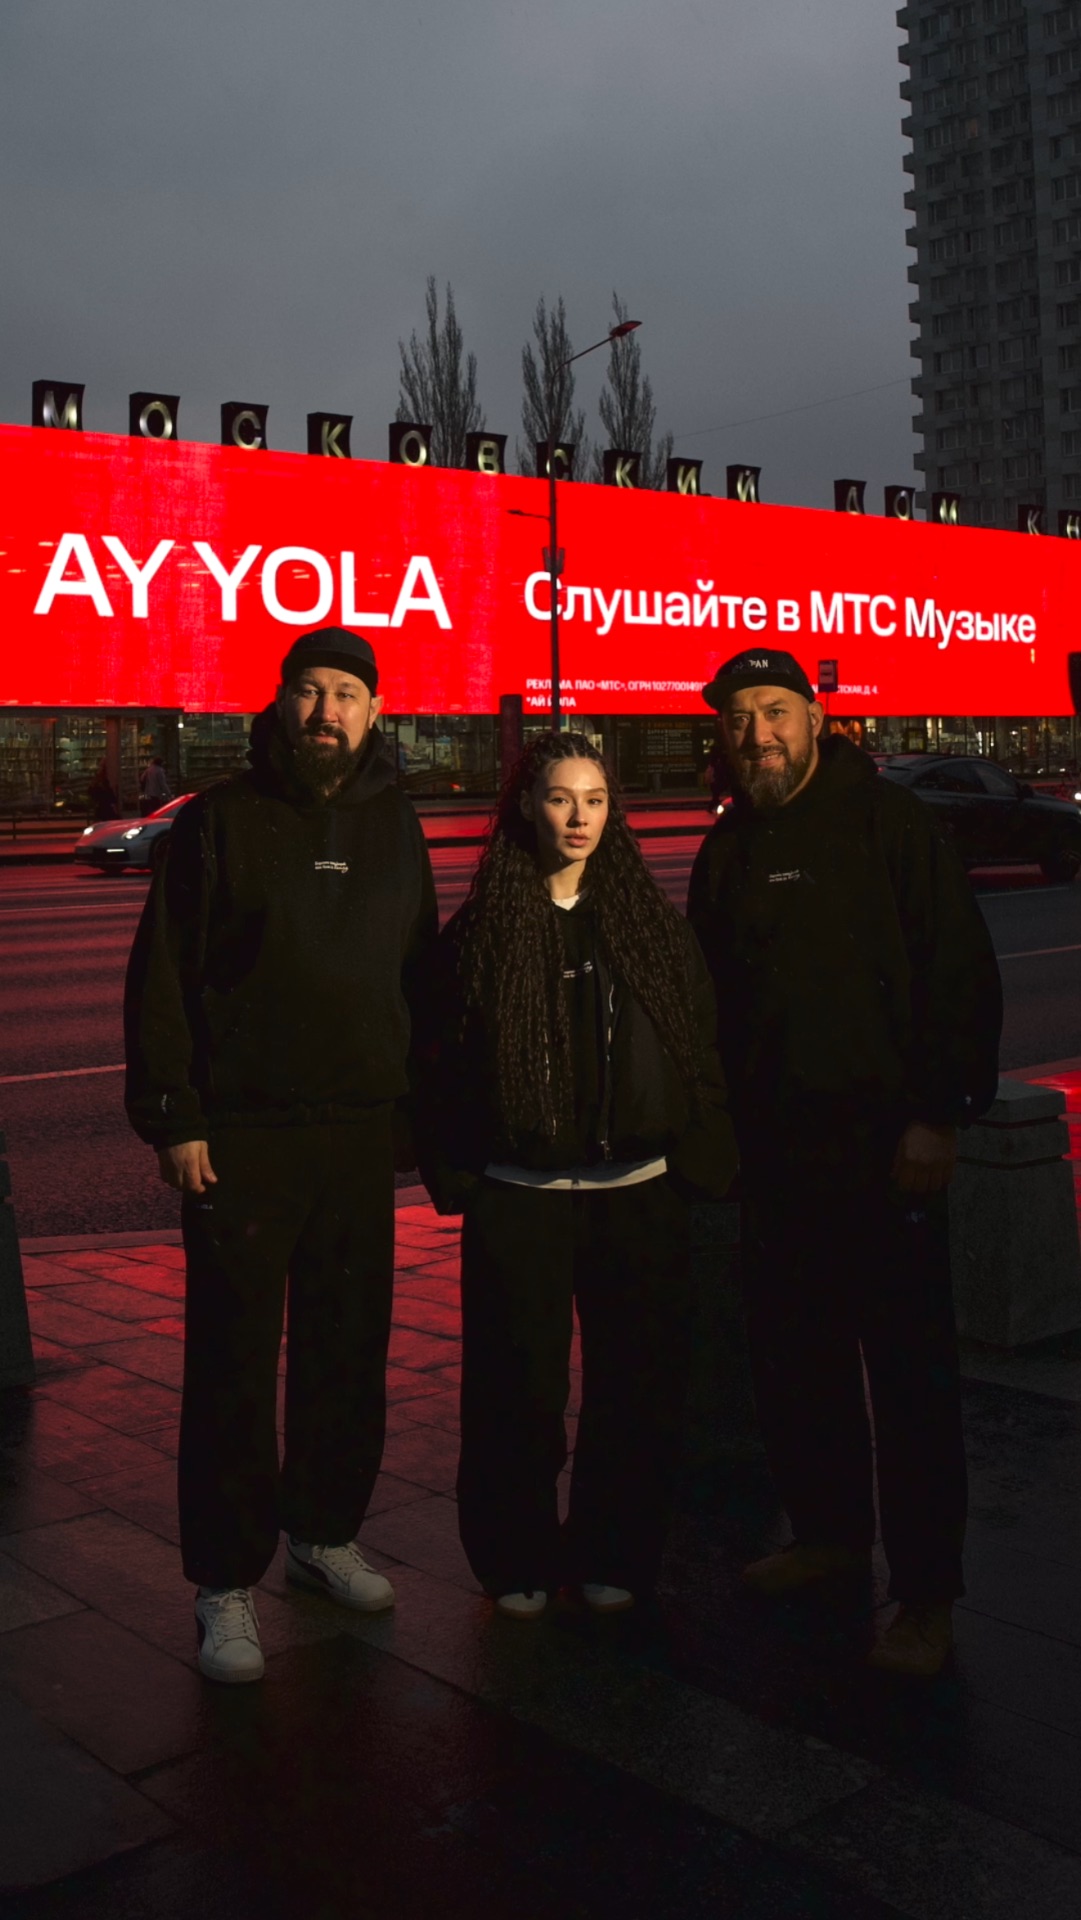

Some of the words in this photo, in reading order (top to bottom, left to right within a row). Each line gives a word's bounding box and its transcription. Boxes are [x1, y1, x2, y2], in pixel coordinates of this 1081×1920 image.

[43, 389, 758, 503] МОСКОВСКИЙ
[845, 486, 960, 525] ДОМ
[33, 532, 176, 618] AY
[192, 544, 453, 630] YOLA
[524, 571, 768, 635] Слушайте
[777, 599, 801, 632] в
[810, 590, 897, 637] МТС
[905, 596, 1036, 650] Музыке
[526, 678, 574, 690] РЕКЛМА.
[575, 679, 595, 690] ПАО
